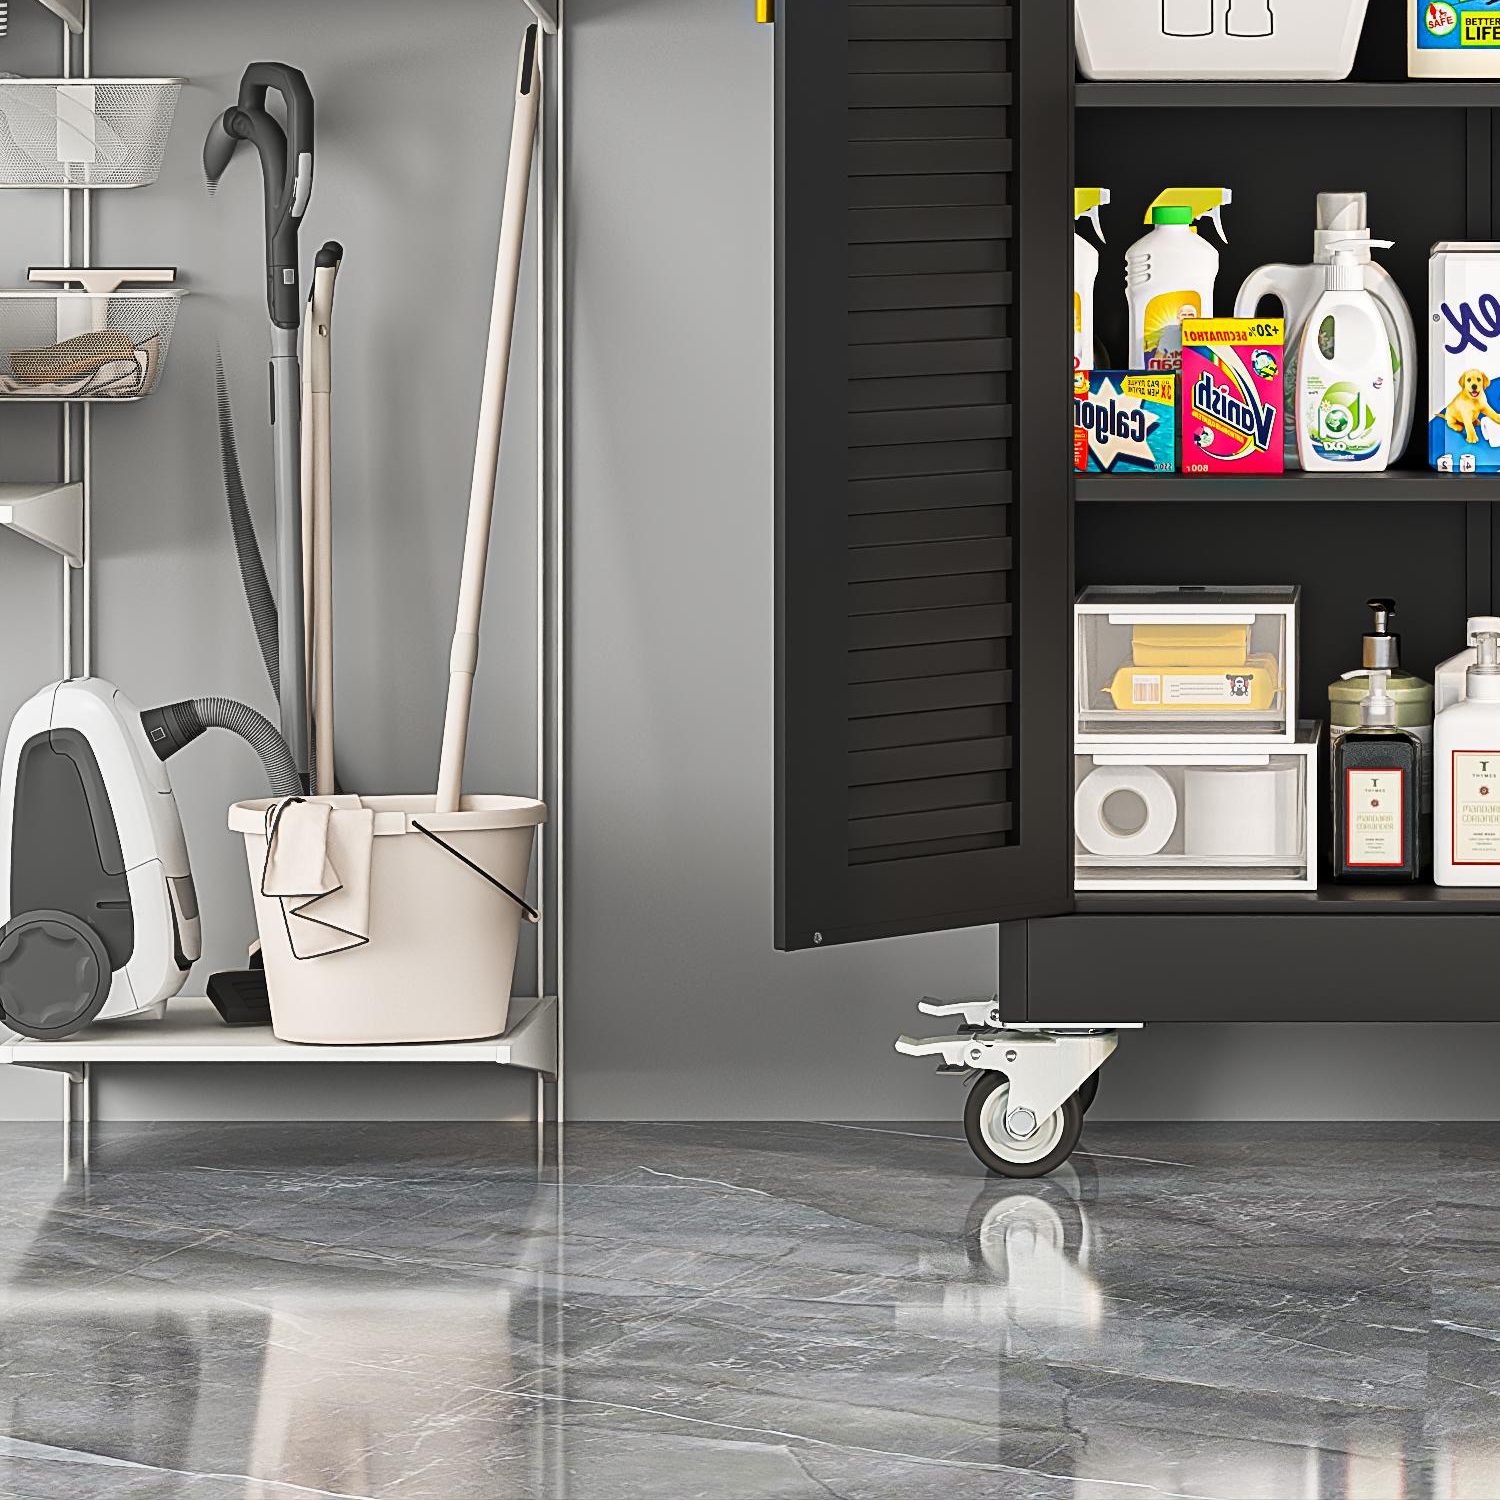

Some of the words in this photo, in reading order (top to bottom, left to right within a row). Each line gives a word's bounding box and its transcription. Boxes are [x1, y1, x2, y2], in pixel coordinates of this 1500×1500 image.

[1428, 15, 1455, 29] SAFE
[1480, 761, 1489, 771] T
[1371, 778, 1379, 787] T
